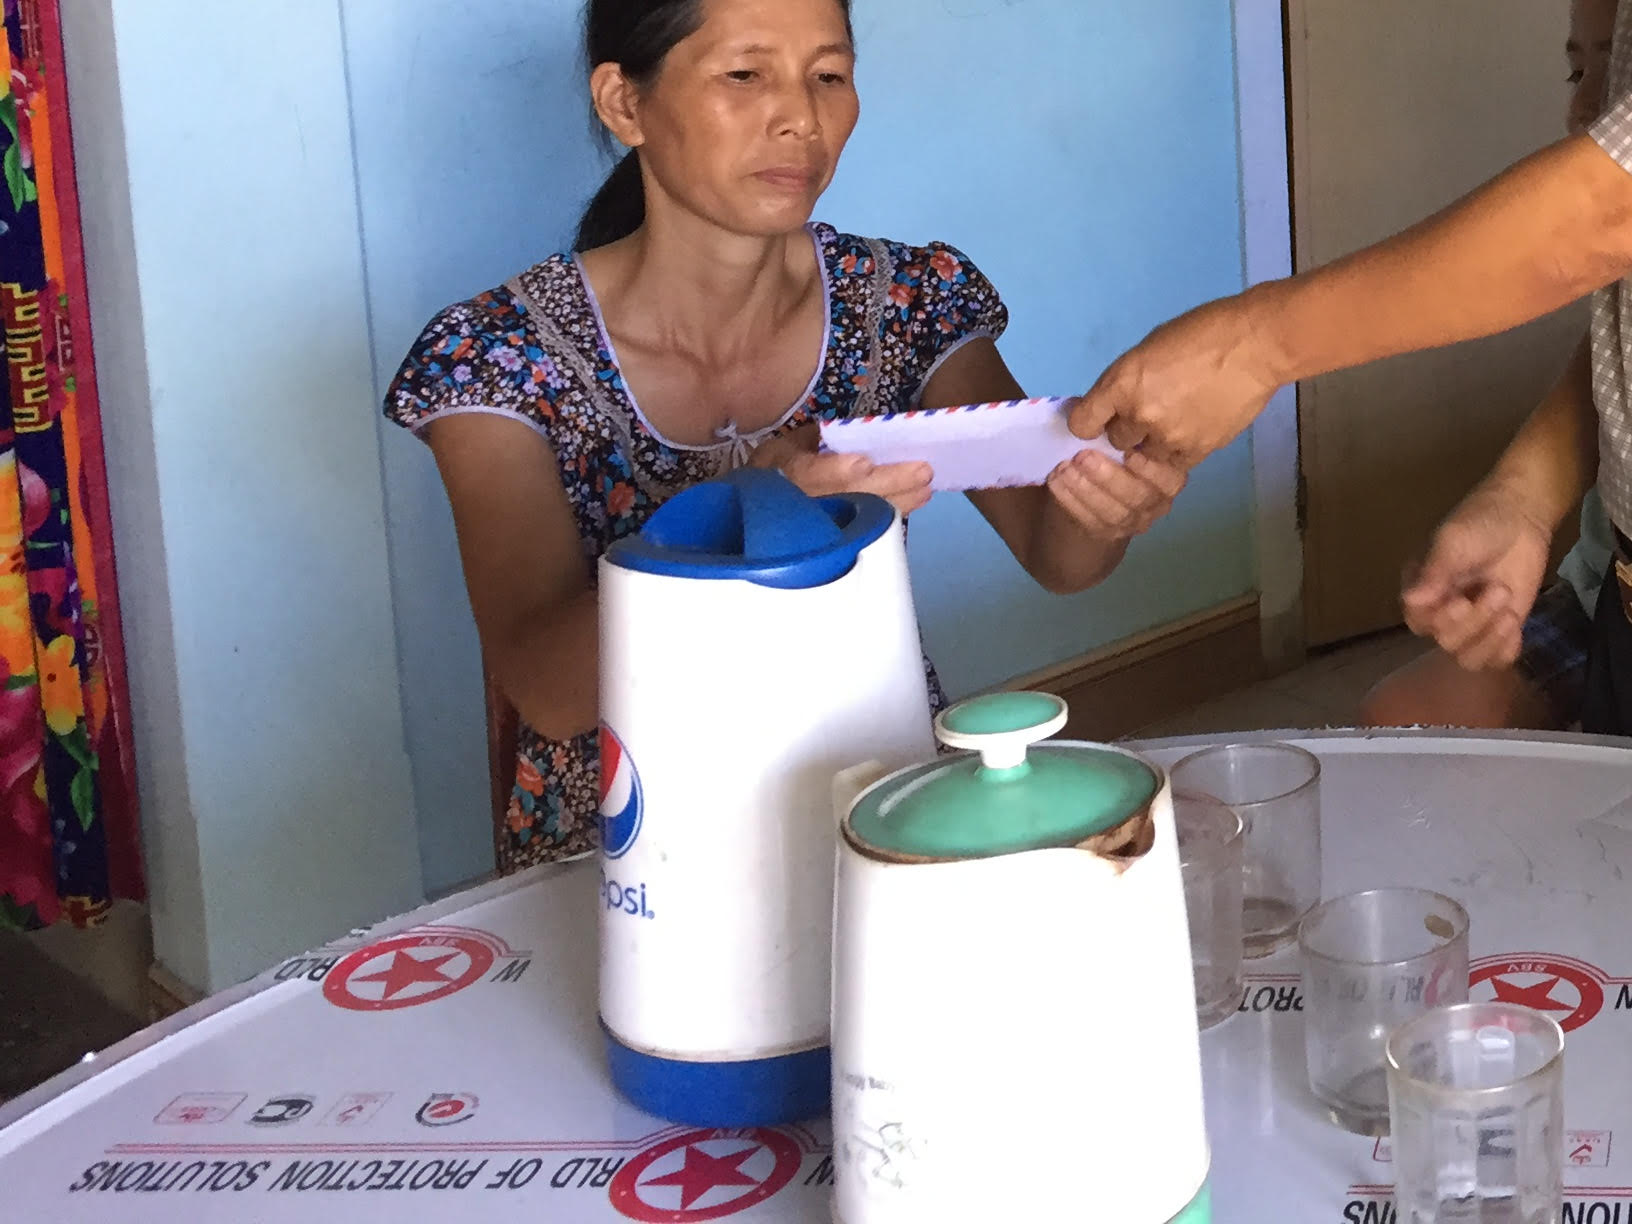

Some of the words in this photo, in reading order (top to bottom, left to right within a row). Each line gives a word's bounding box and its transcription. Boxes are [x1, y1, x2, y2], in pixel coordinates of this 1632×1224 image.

[68, 1160, 272, 1193] SOLUTIONS
[267, 1159, 489, 1192] PROTECTION
[485, 1157, 544, 1190] OF
